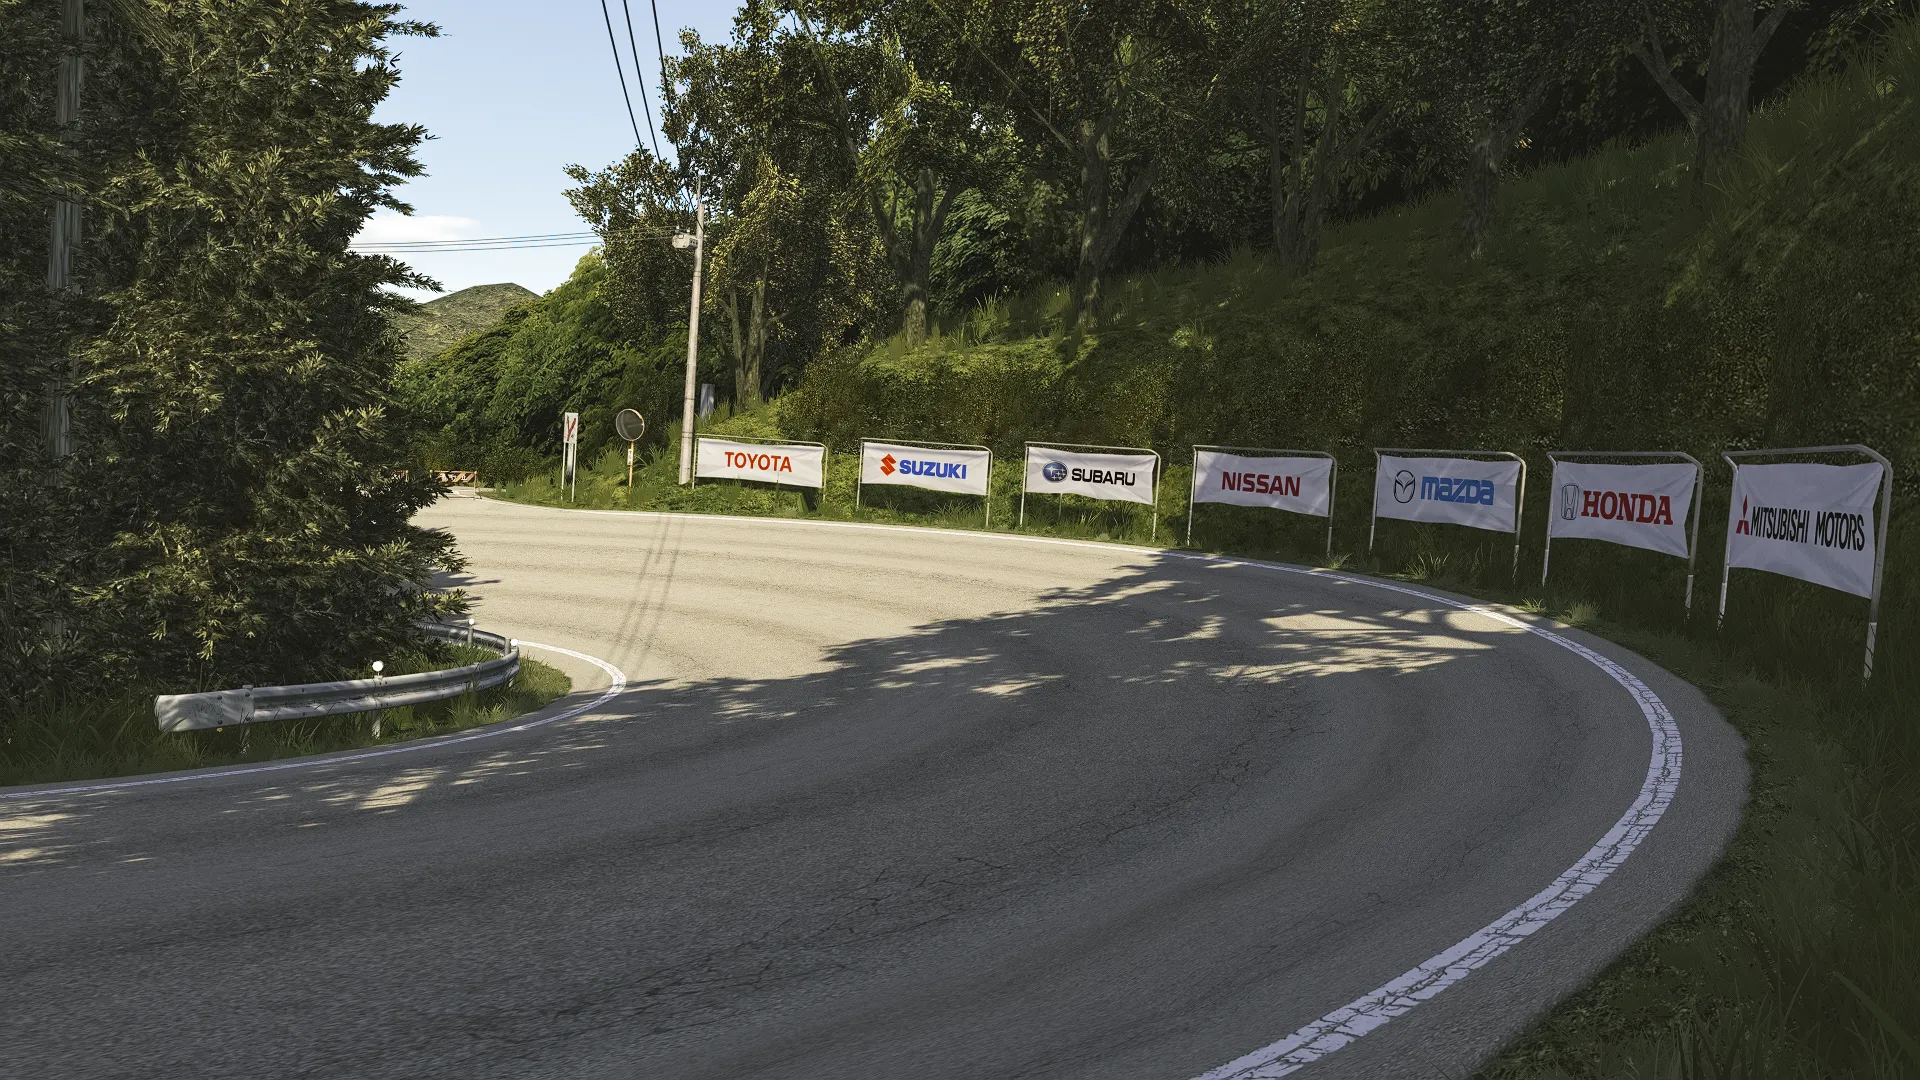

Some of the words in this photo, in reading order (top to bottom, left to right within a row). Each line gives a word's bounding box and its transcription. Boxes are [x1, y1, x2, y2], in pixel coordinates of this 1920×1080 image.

[725, 452, 792, 473] TOYOTA
[899, 460, 967, 480] SUZUKI
[1071, 468, 1136, 486] SUBARU
[1222, 471, 1300, 497] NISSAN
[1581, 491, 1673, 525] HONDA
[1751, 506, 1810, 544] MITSUBISHI
[1815, 511, 1865, 551] MOTORS
